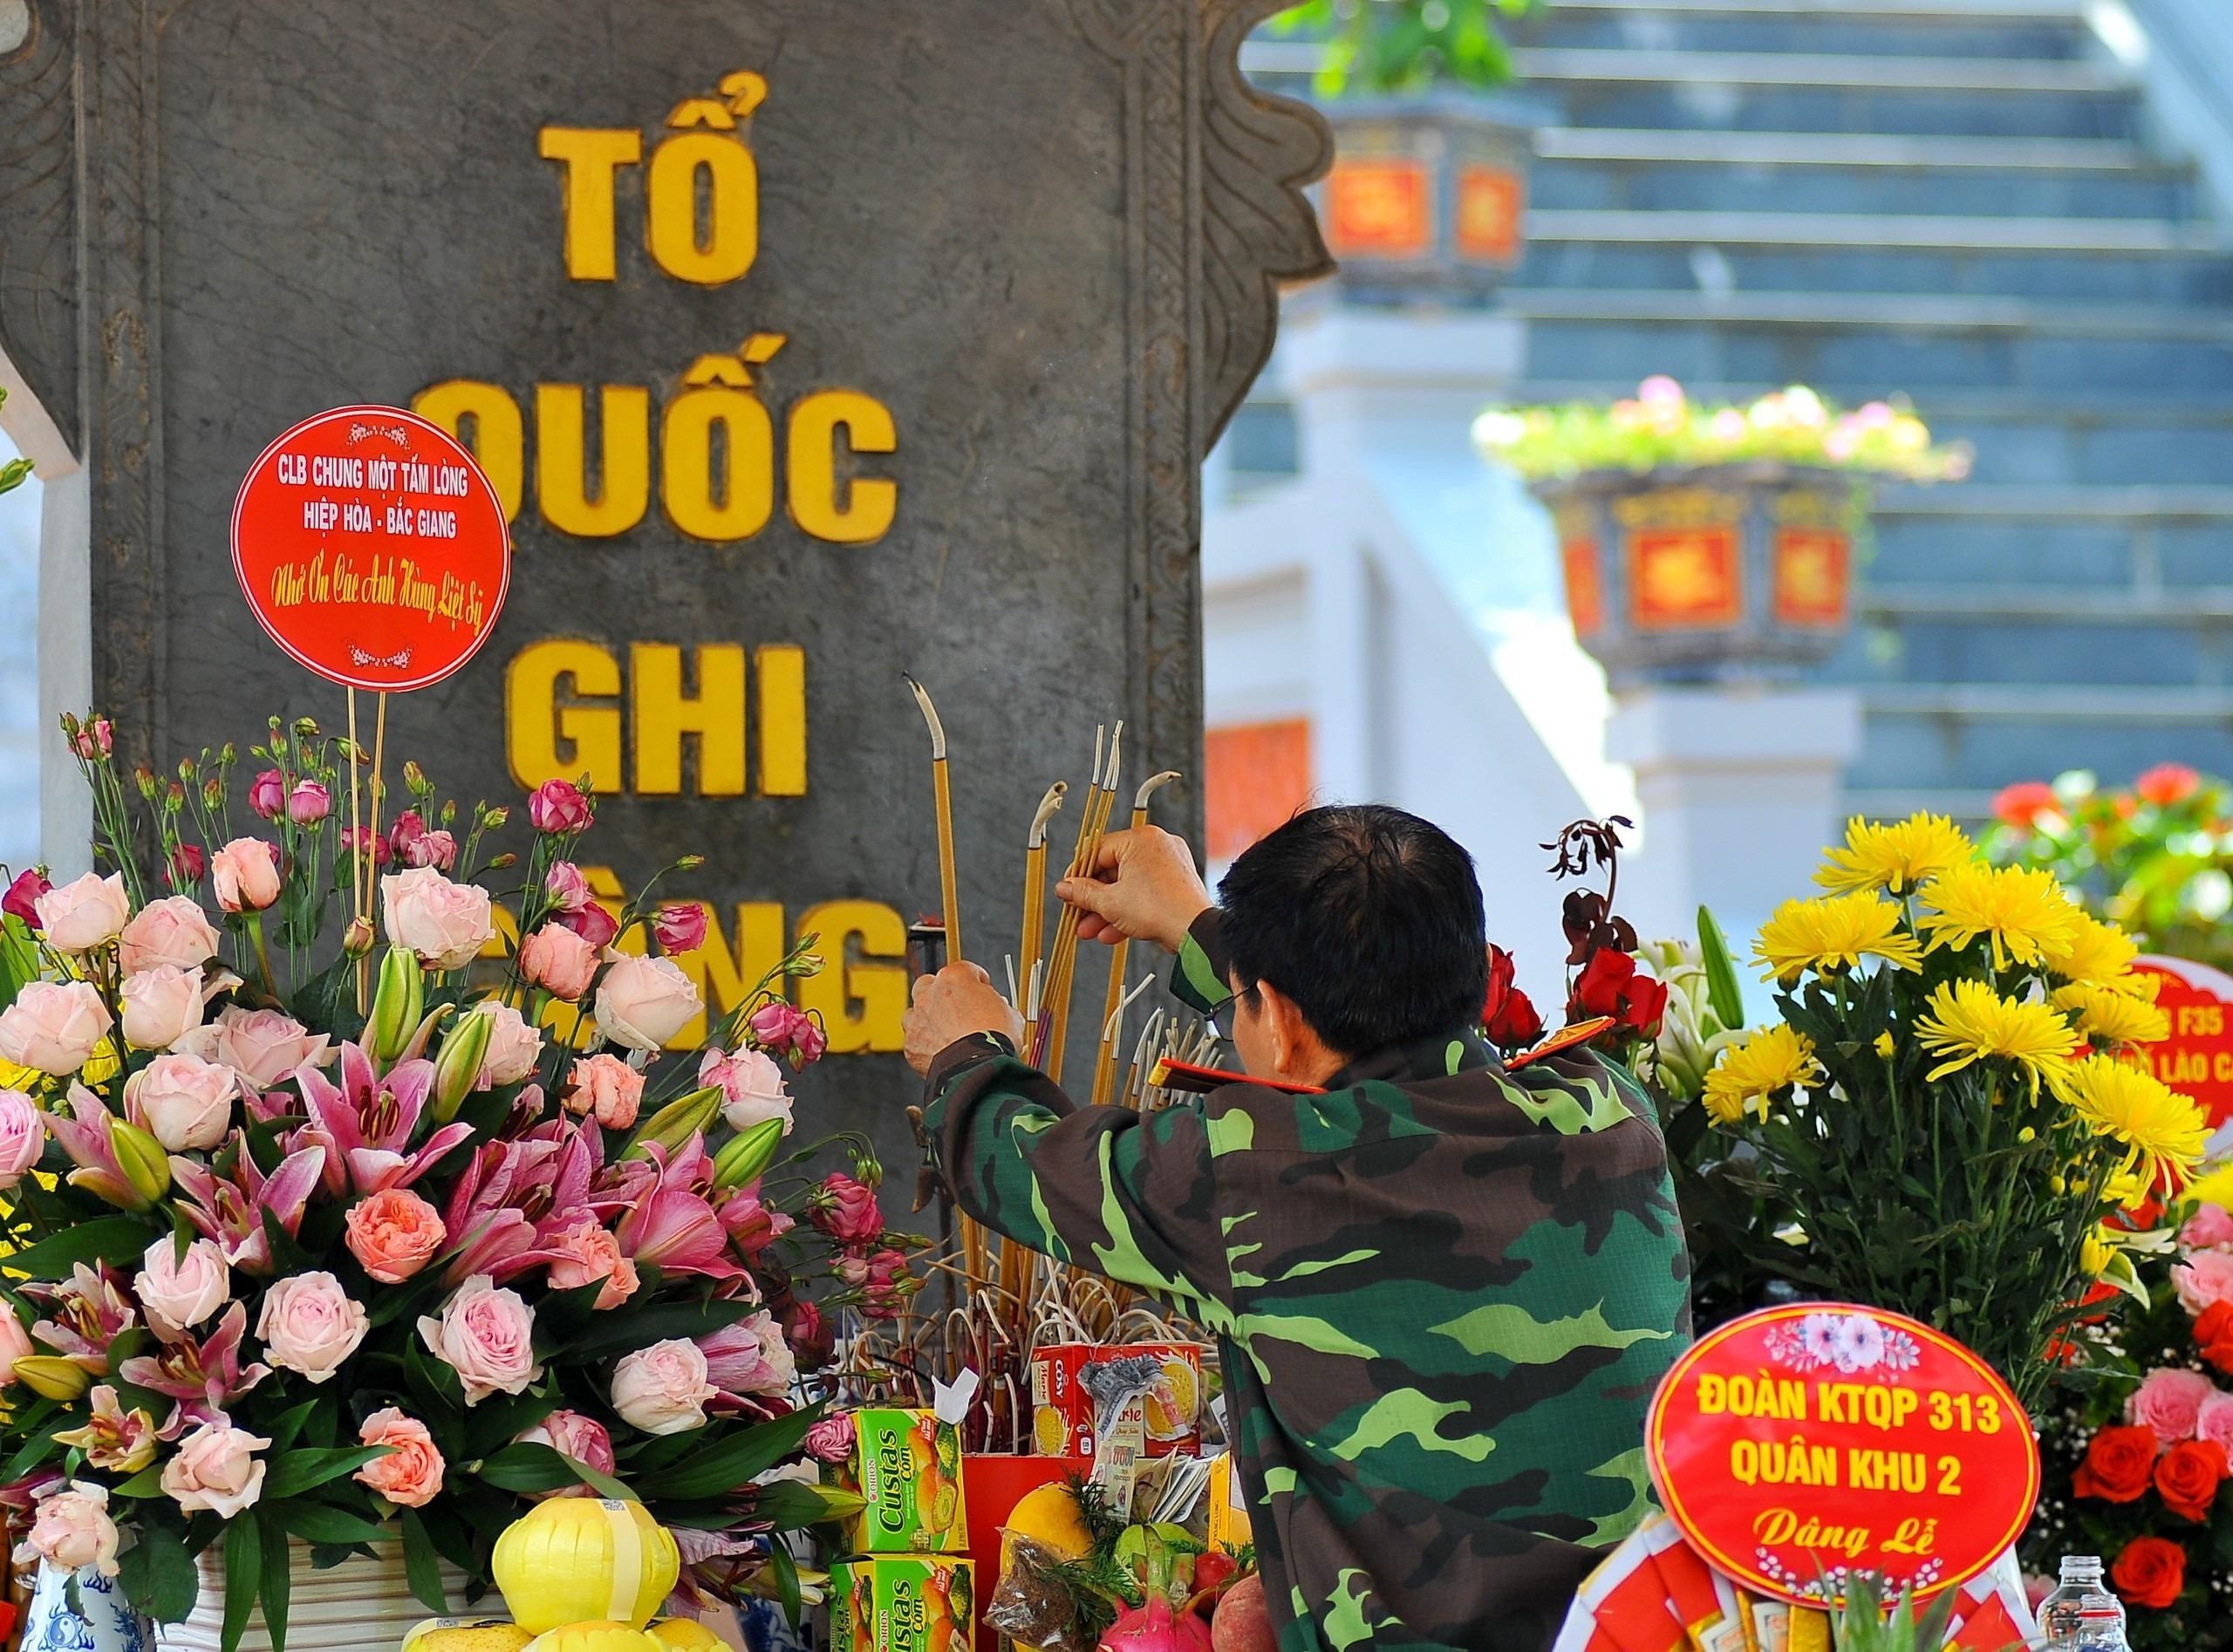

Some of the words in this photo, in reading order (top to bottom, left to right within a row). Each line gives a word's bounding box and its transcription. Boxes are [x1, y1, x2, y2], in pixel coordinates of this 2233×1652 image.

[538, 70, 768, 285] TỔ
[277, 453, 307, 486] CLB
[312, 455, 363, 490] CHUNG
[368, 454, 397, 500] MỘT
[401, 453, 429, 494] TẤM
[433, 458, 468, 497] LÒNG
[304, 495, 338, 538] HIỆP
[344, 496, 373, 533] HÒA
[386, 495, 413, 536] BẮC
[417, 509, 457, 539] GIANG
[270, 563, 307, 608] Nhớ
[309, 547, 330, 604] Ơn
[332, 552, 359, 604] Các
[361, 553, 396, 606] Anh
[399, 557, 437, 624] Hùng
[437, 570, 465, 631] Liệt
[507, 638, 809, 798] GHI
[2158, 1048, 2209, 1083] LÀO
[1055, 1359, 1064, 1399] COSY
[1697, 1369, 1806, 1421] ĐOÀN
[1819, 1382, 1918, 1432] KTQP
[1928, 1391, 2002, 1435] 313
[868, 1459, 877, 1492] ORION
[878, 1428, 905, 1534] Custas
[1730, 1435, 1837, 1488] QUÂN
[1848, 1450, 1926, 1494] KHU
[1936, 1455, 1961, 1496] 2
[1752, 1507, 1871, 1558] Dâng
[1880, 1517, 1938, 1556] Lễ
[879, 1609, 888, 1642] ORION
